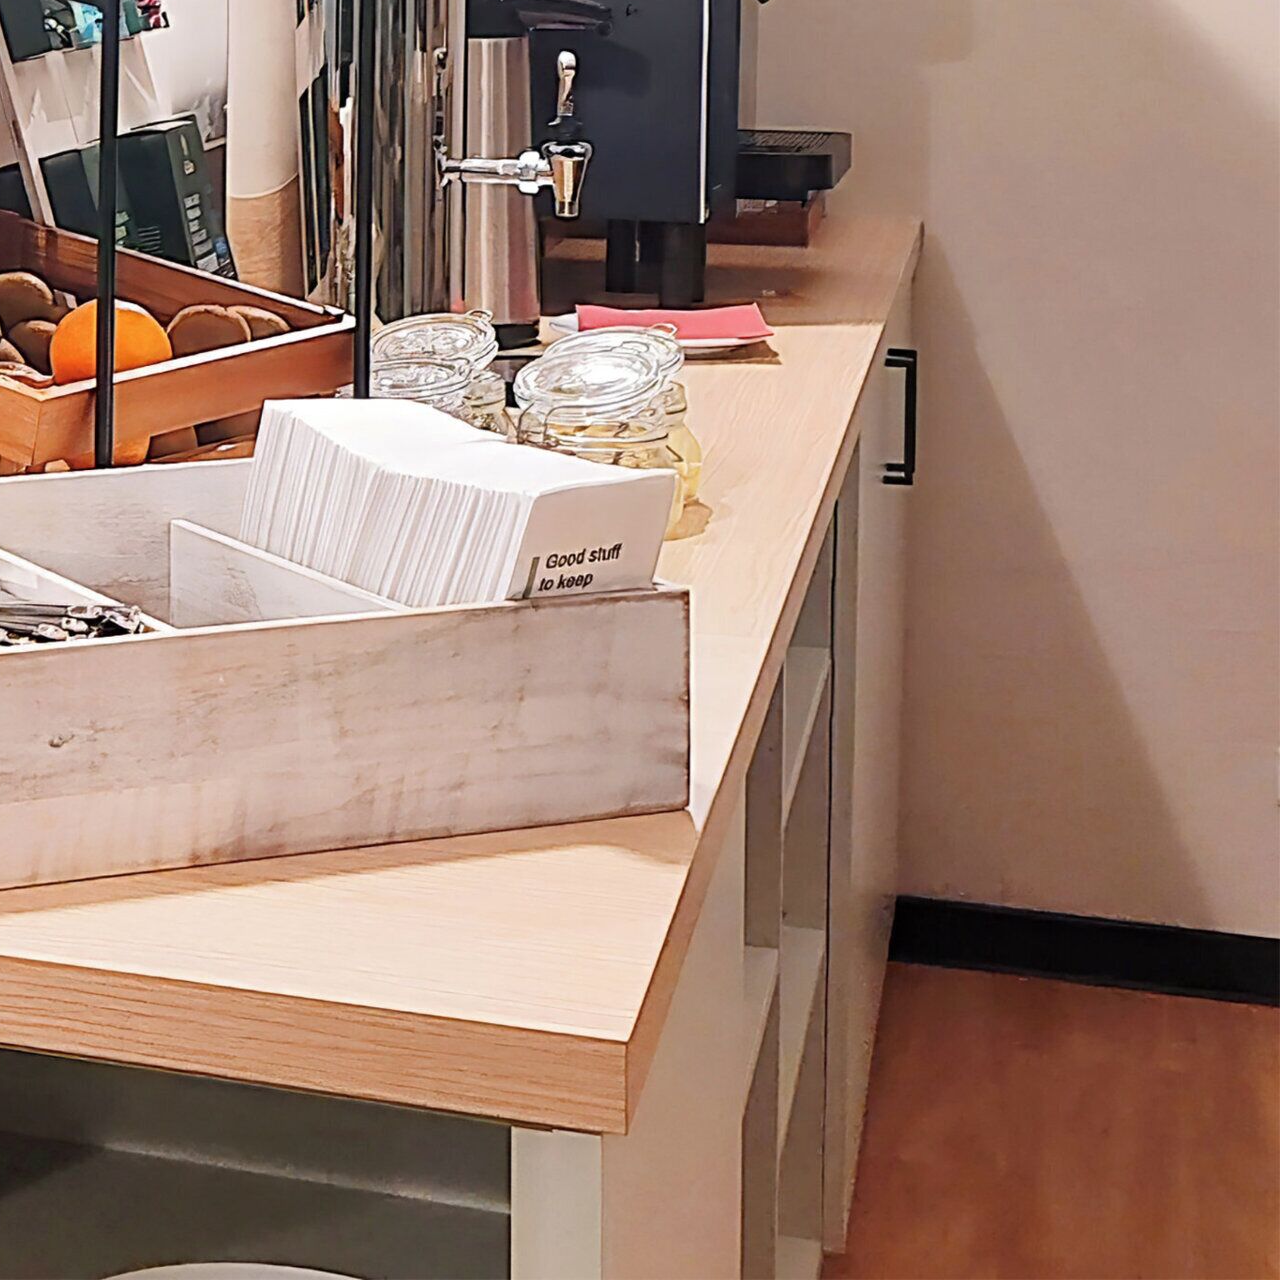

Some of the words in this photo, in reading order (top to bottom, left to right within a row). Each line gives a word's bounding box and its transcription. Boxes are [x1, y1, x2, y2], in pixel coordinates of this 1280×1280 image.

[546, 548, 586, 569] Good
[587, 543, 623, 563] stuff
[538, 577, 554, 592] to
[557, 572, 594, 590] keep
